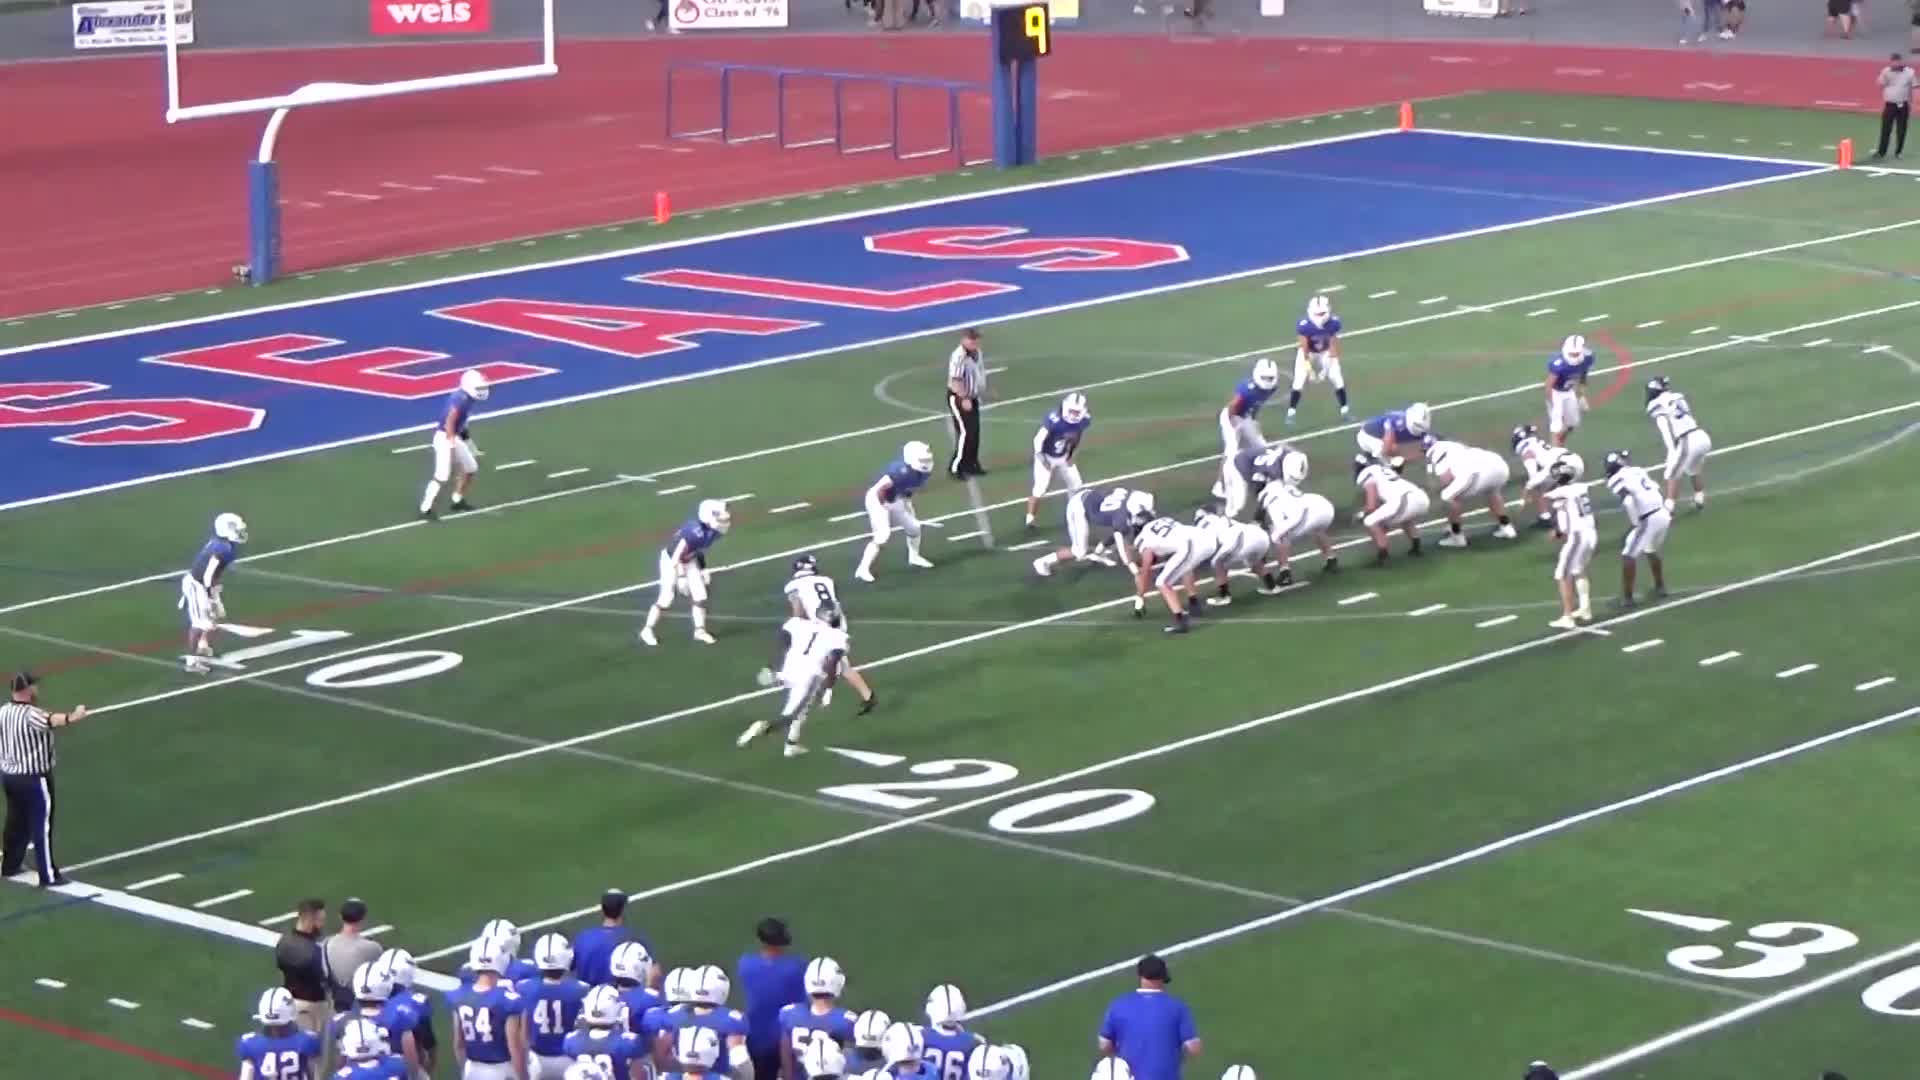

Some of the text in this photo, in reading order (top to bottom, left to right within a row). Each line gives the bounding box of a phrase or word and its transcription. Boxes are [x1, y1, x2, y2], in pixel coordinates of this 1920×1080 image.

[387, 0, 471, 23] weis
[704, 7, 740, 18] Class
[744, 7, 757, 17] of
[1025, 6, 1047, 54] 9
[0, 225, 1190, 446] SEALS
[814, 582, 832, 602] 8
[459, 1005, 493, 1042] 64
[533, 999, 564, 1034] 41
[260, 1051, 300, 1080] 42
